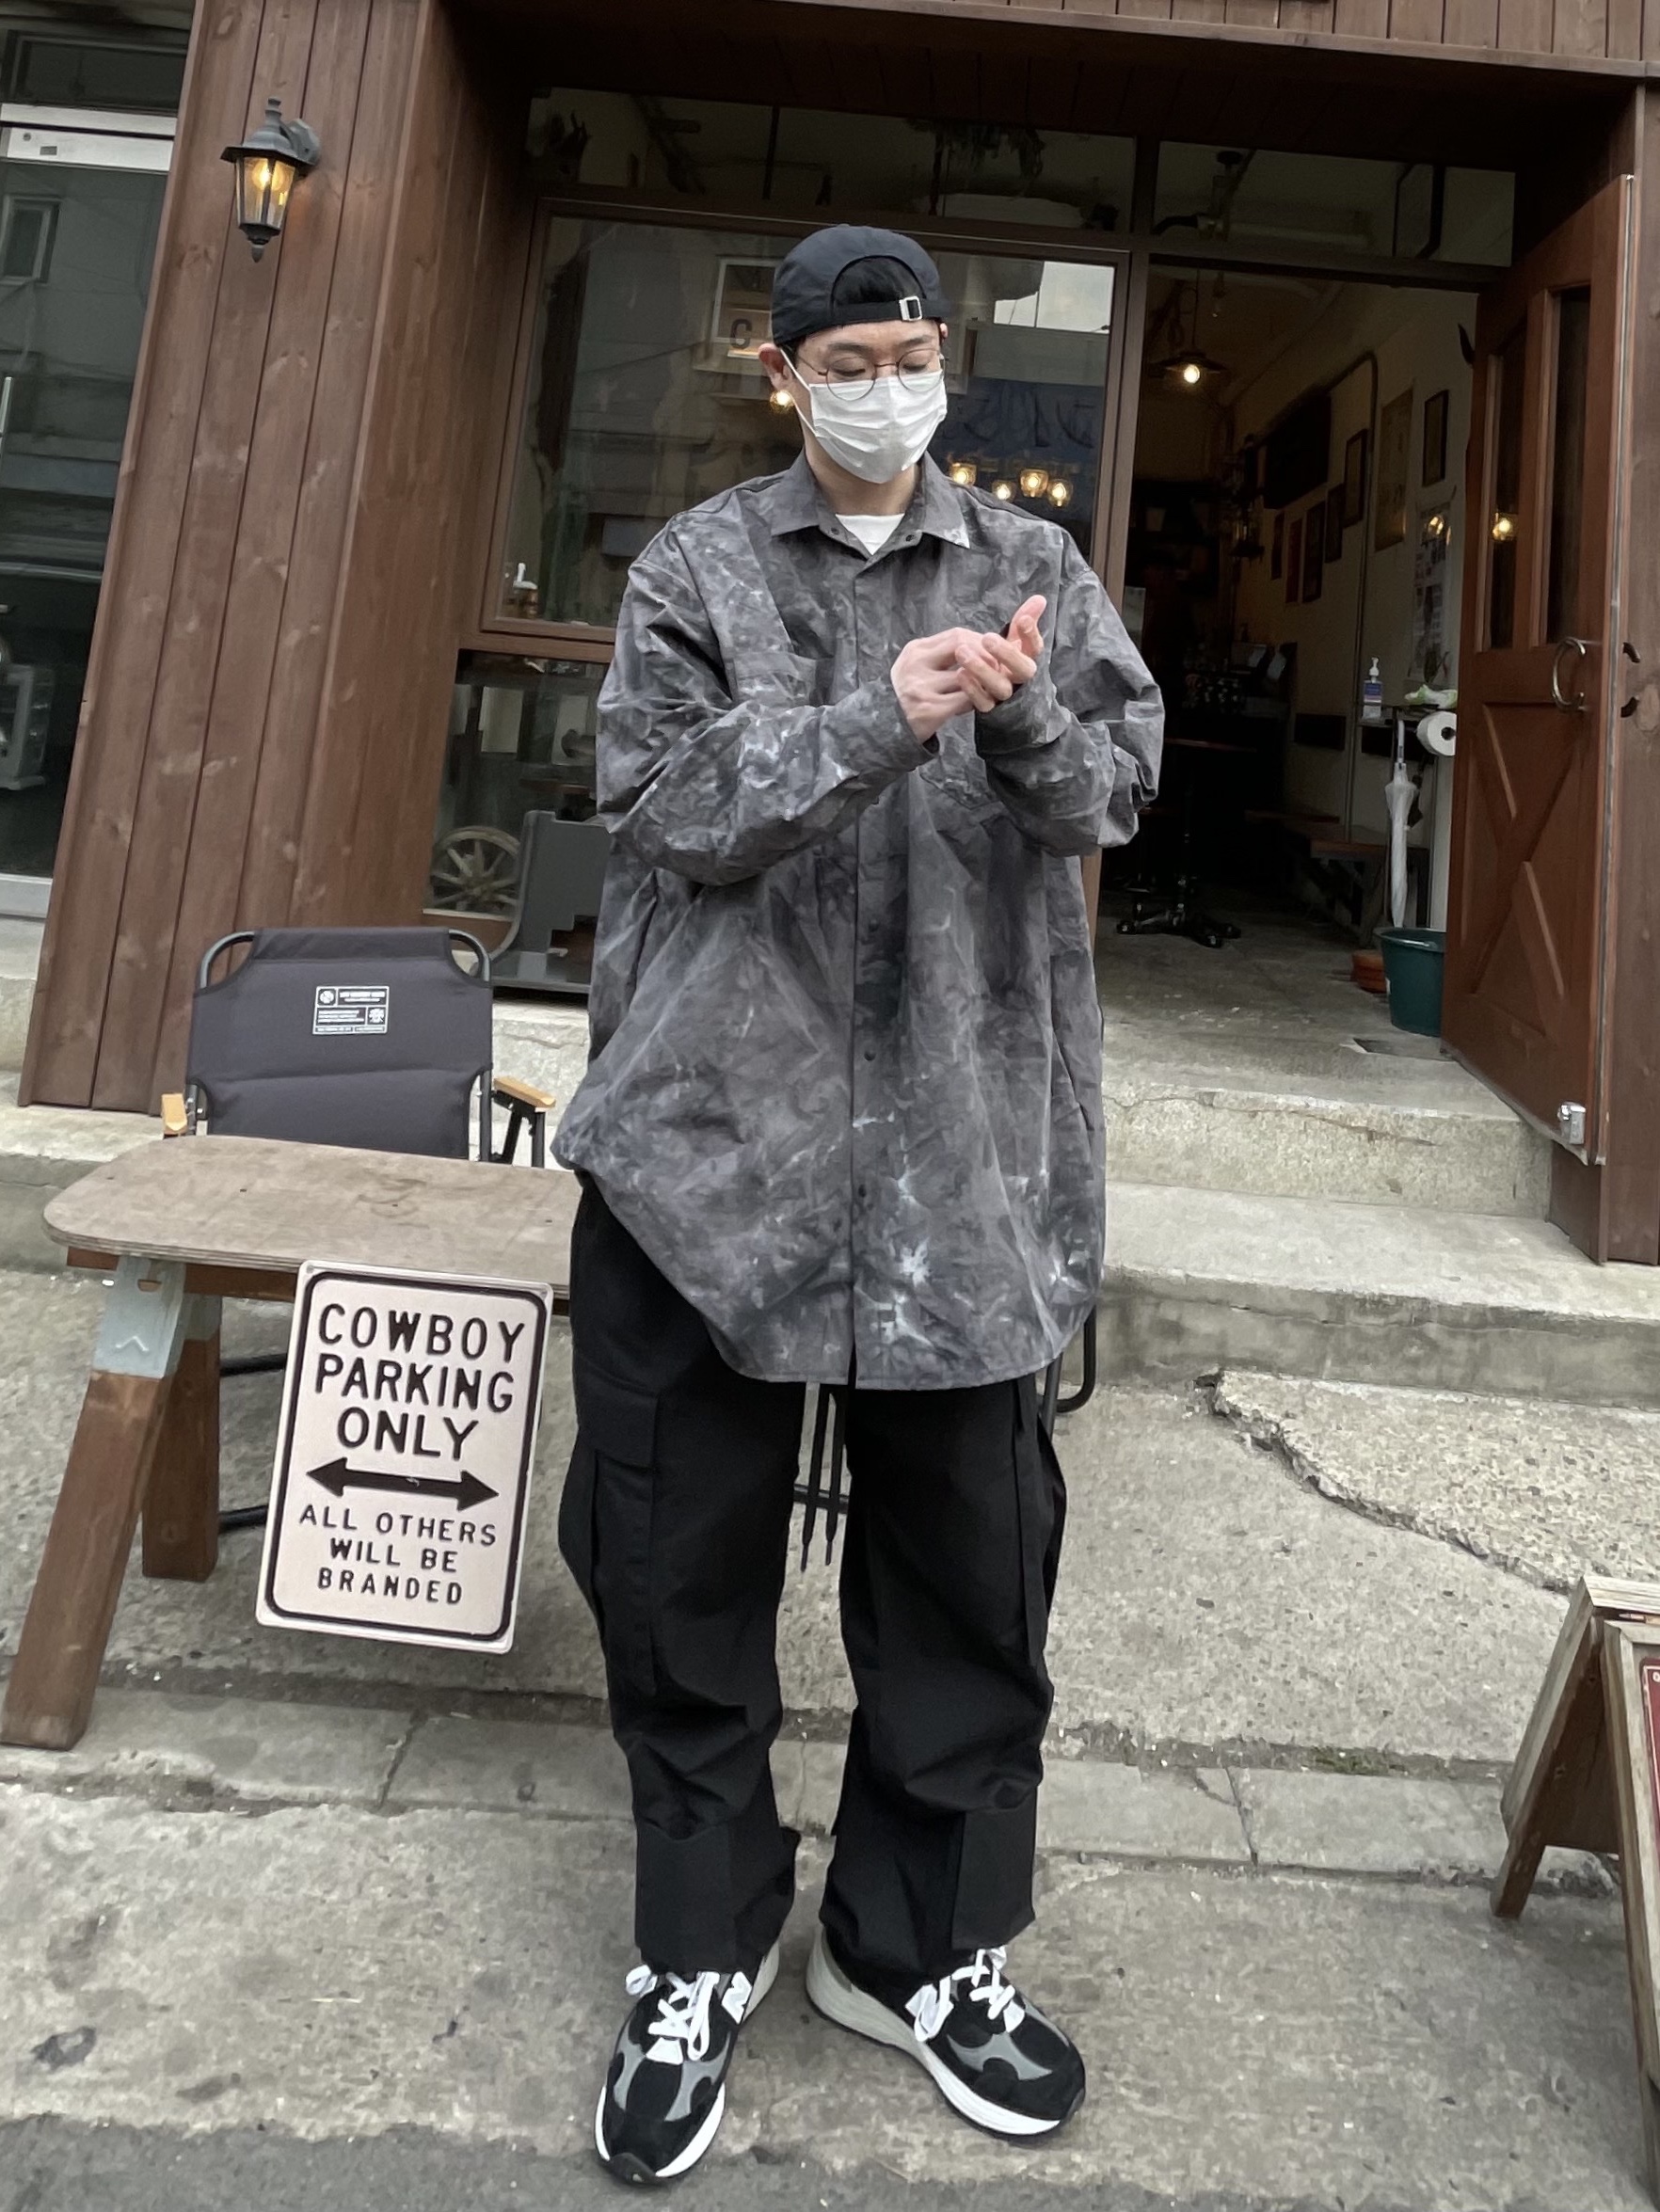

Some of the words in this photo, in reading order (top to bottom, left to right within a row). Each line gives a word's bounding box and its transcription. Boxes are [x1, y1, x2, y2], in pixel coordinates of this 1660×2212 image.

[318, 1303, 525, 1363] COWBOY
[315, 1352, 515, 1414] PARKING
[337, 1407, 480, 1461] ONLY
[299, 1504, 358, 1531] ALL
[375, 1512, 497, 1547] OTHERS
[329, 1537, 401, 1567] WILL
[420, 1548, 458, 1574] BE
[316, 1567, 463, 1605] BRANDED
